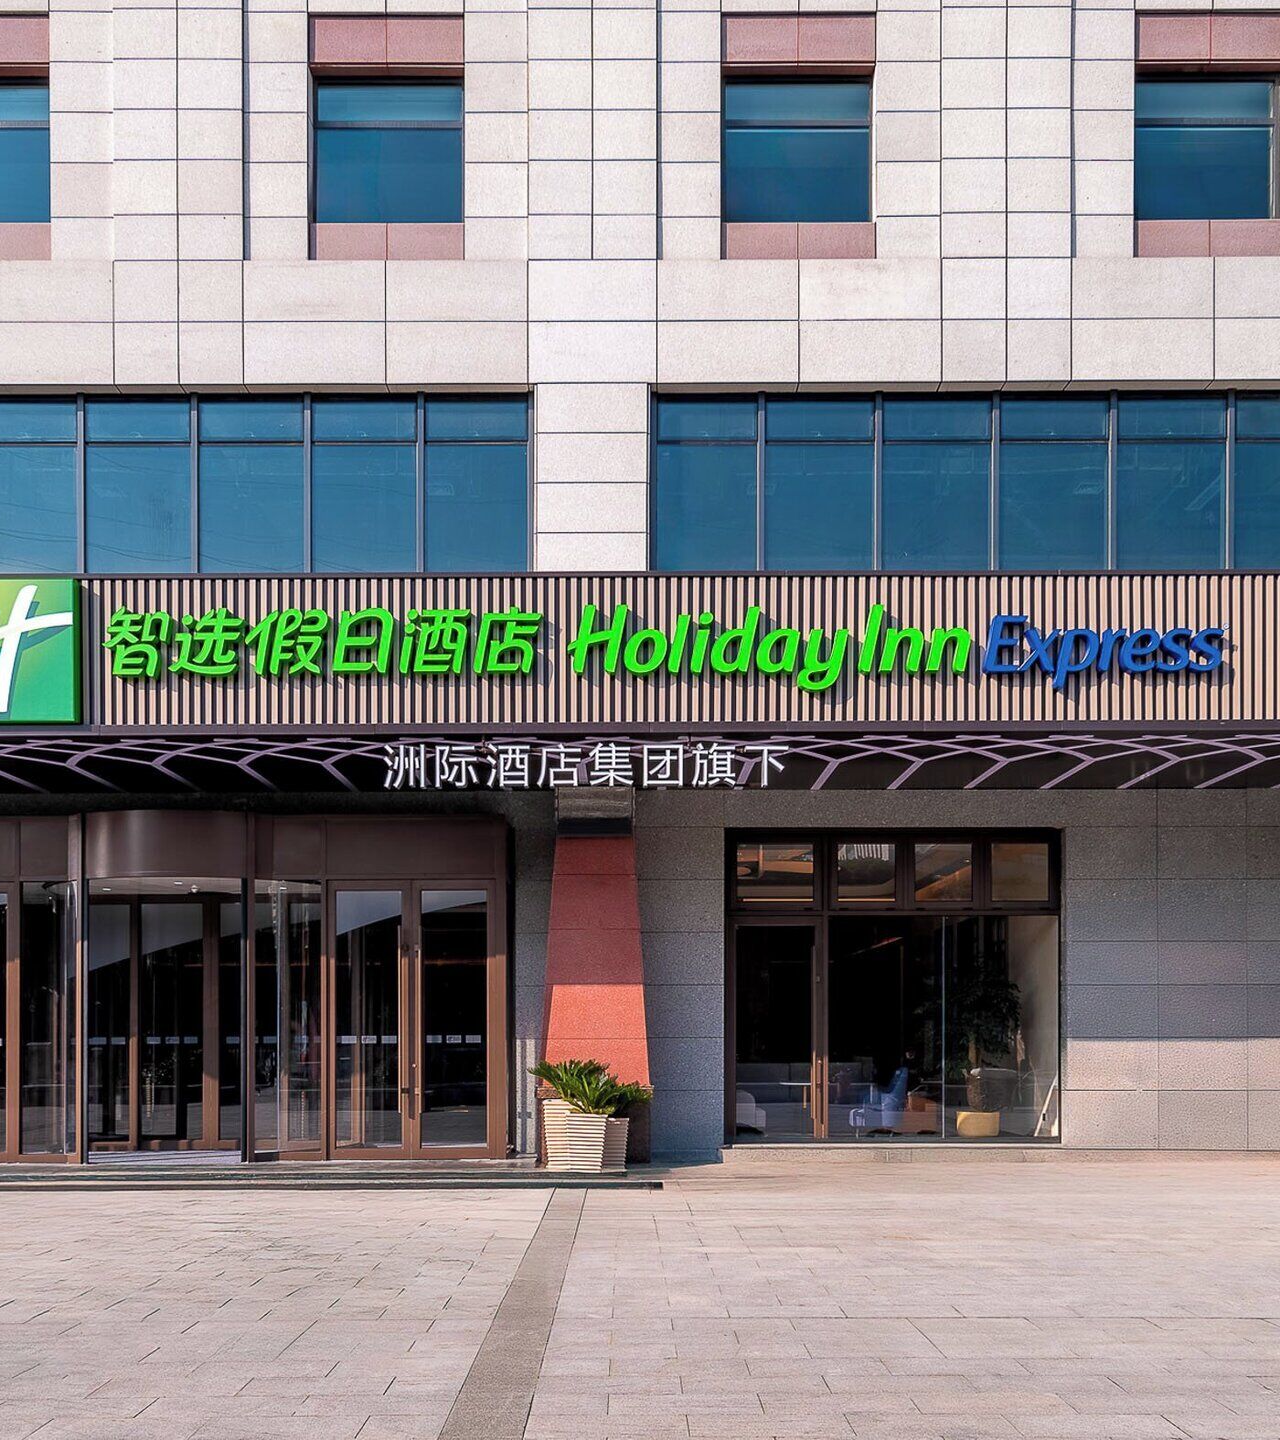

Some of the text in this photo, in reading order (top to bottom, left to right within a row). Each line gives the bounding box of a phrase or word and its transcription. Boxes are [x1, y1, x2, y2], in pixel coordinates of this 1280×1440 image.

[102, 605, 543, 679] 智选假日酒店
[567, 603, 1224, 692] Holiday Inn Express
[383, 742, 790, 788] 洲际酒店集团旗下
